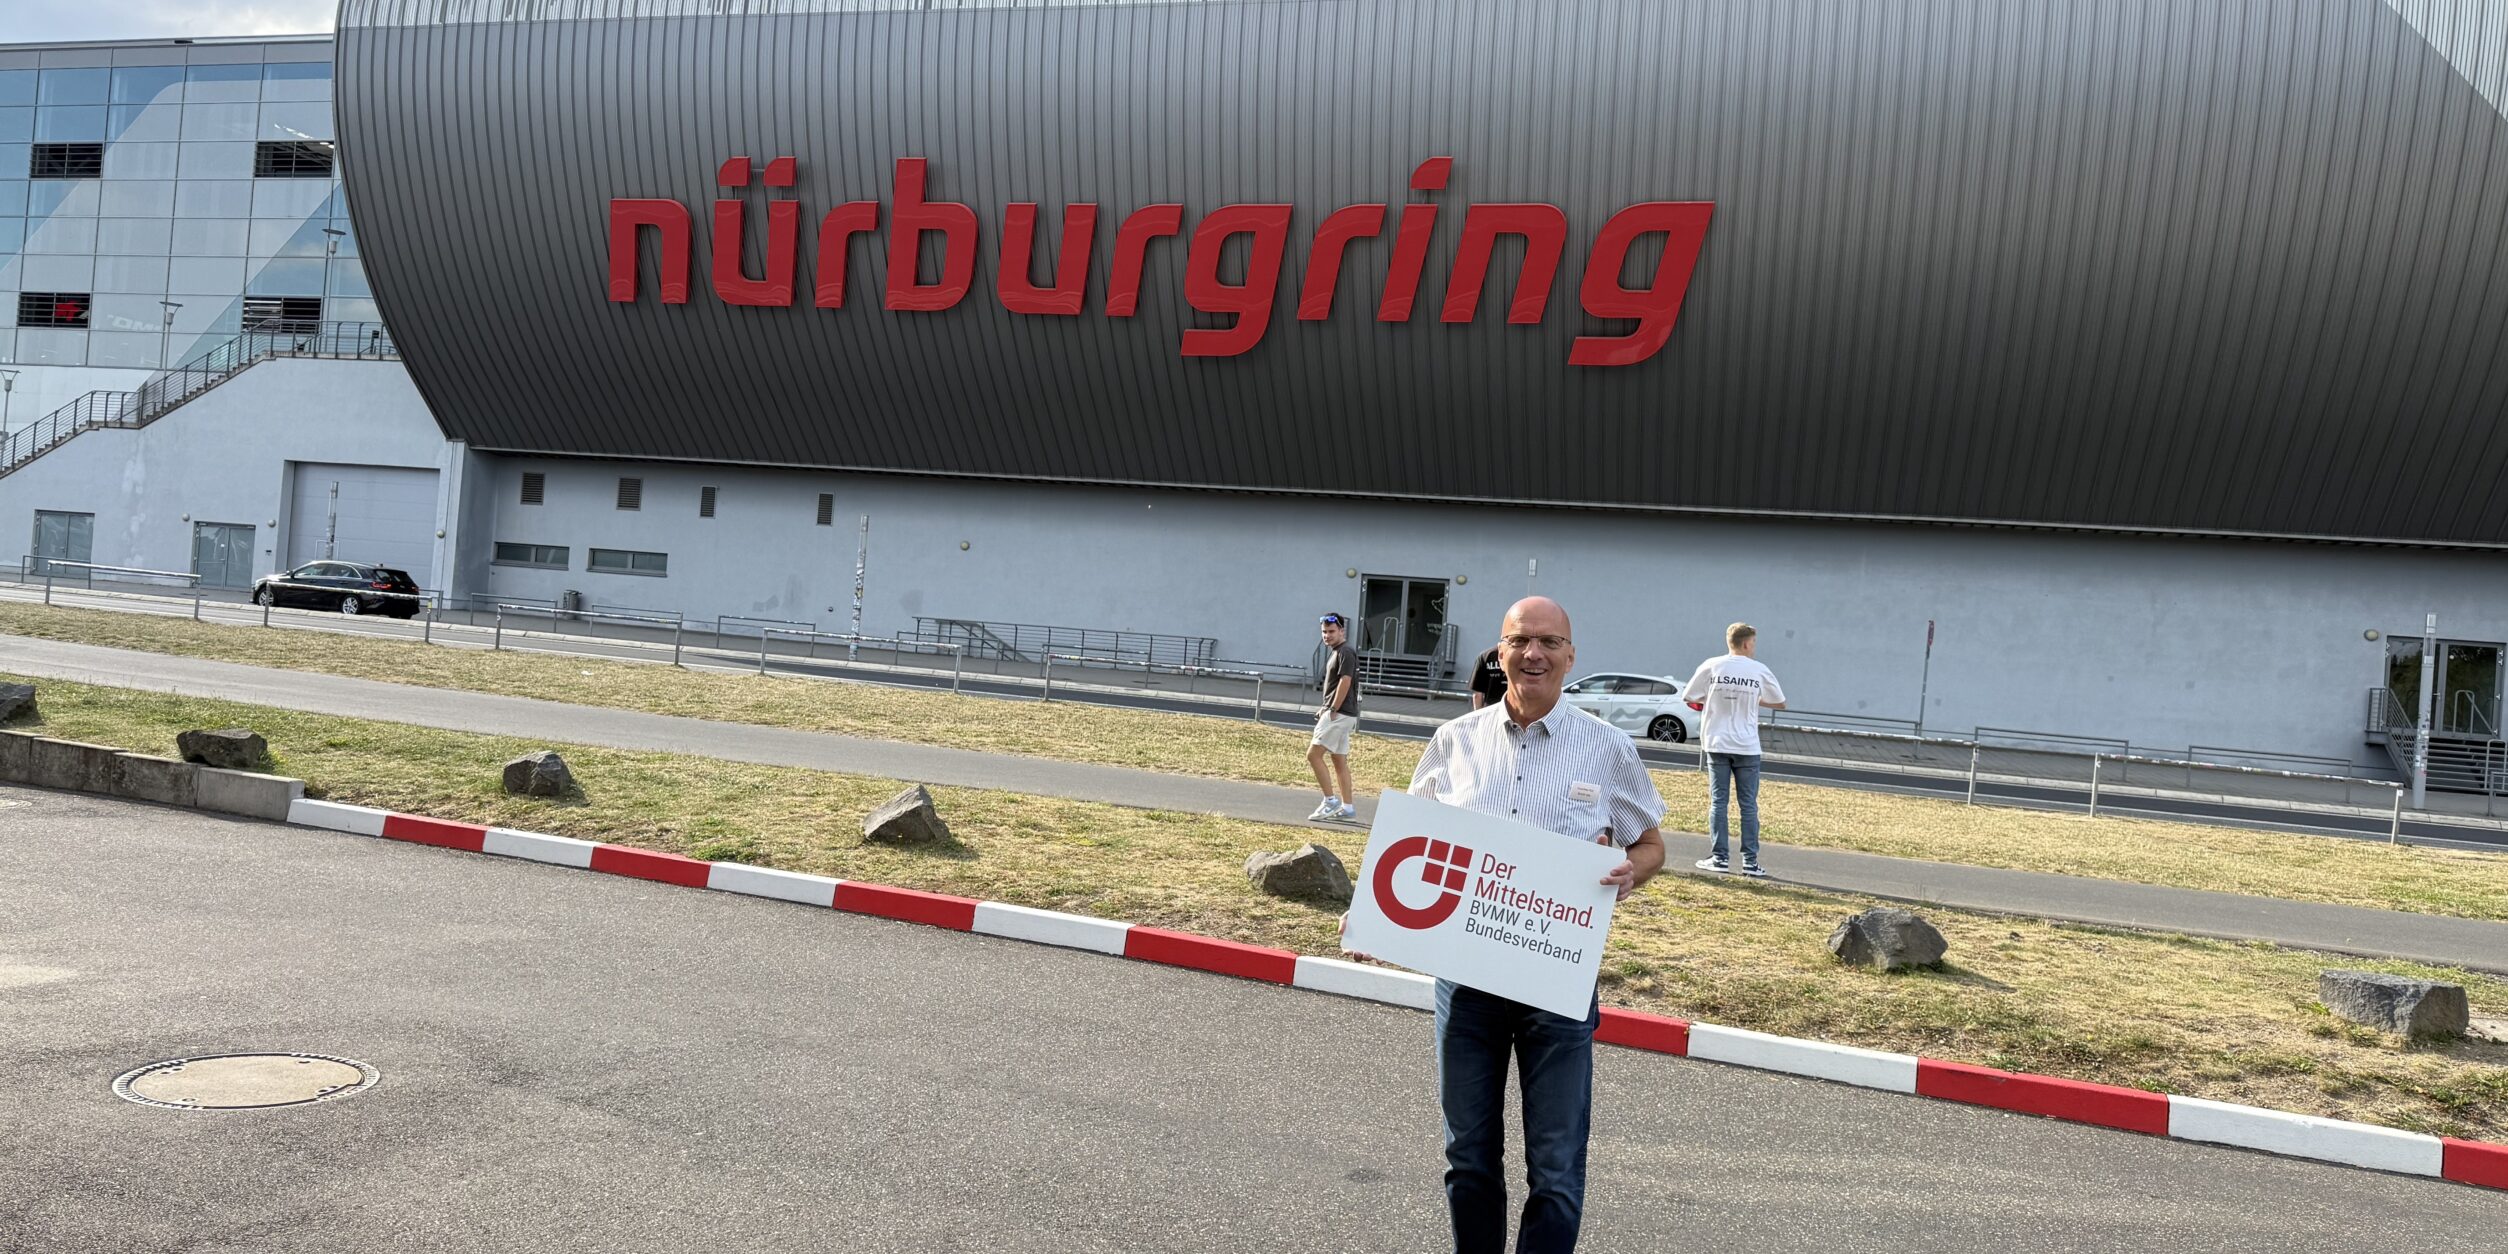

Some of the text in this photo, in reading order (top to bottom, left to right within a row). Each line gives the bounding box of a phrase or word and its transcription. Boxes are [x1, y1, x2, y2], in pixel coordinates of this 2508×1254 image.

[609, 157, 1715, 365] nürburgring
[1481, 853, 1516, 880] Der
[1470, 900, 1520, 926] BVMW
[1474, 876, 1593, 929] Mittelstand.
[1465, 917, 1582, 964] Bundesverband
